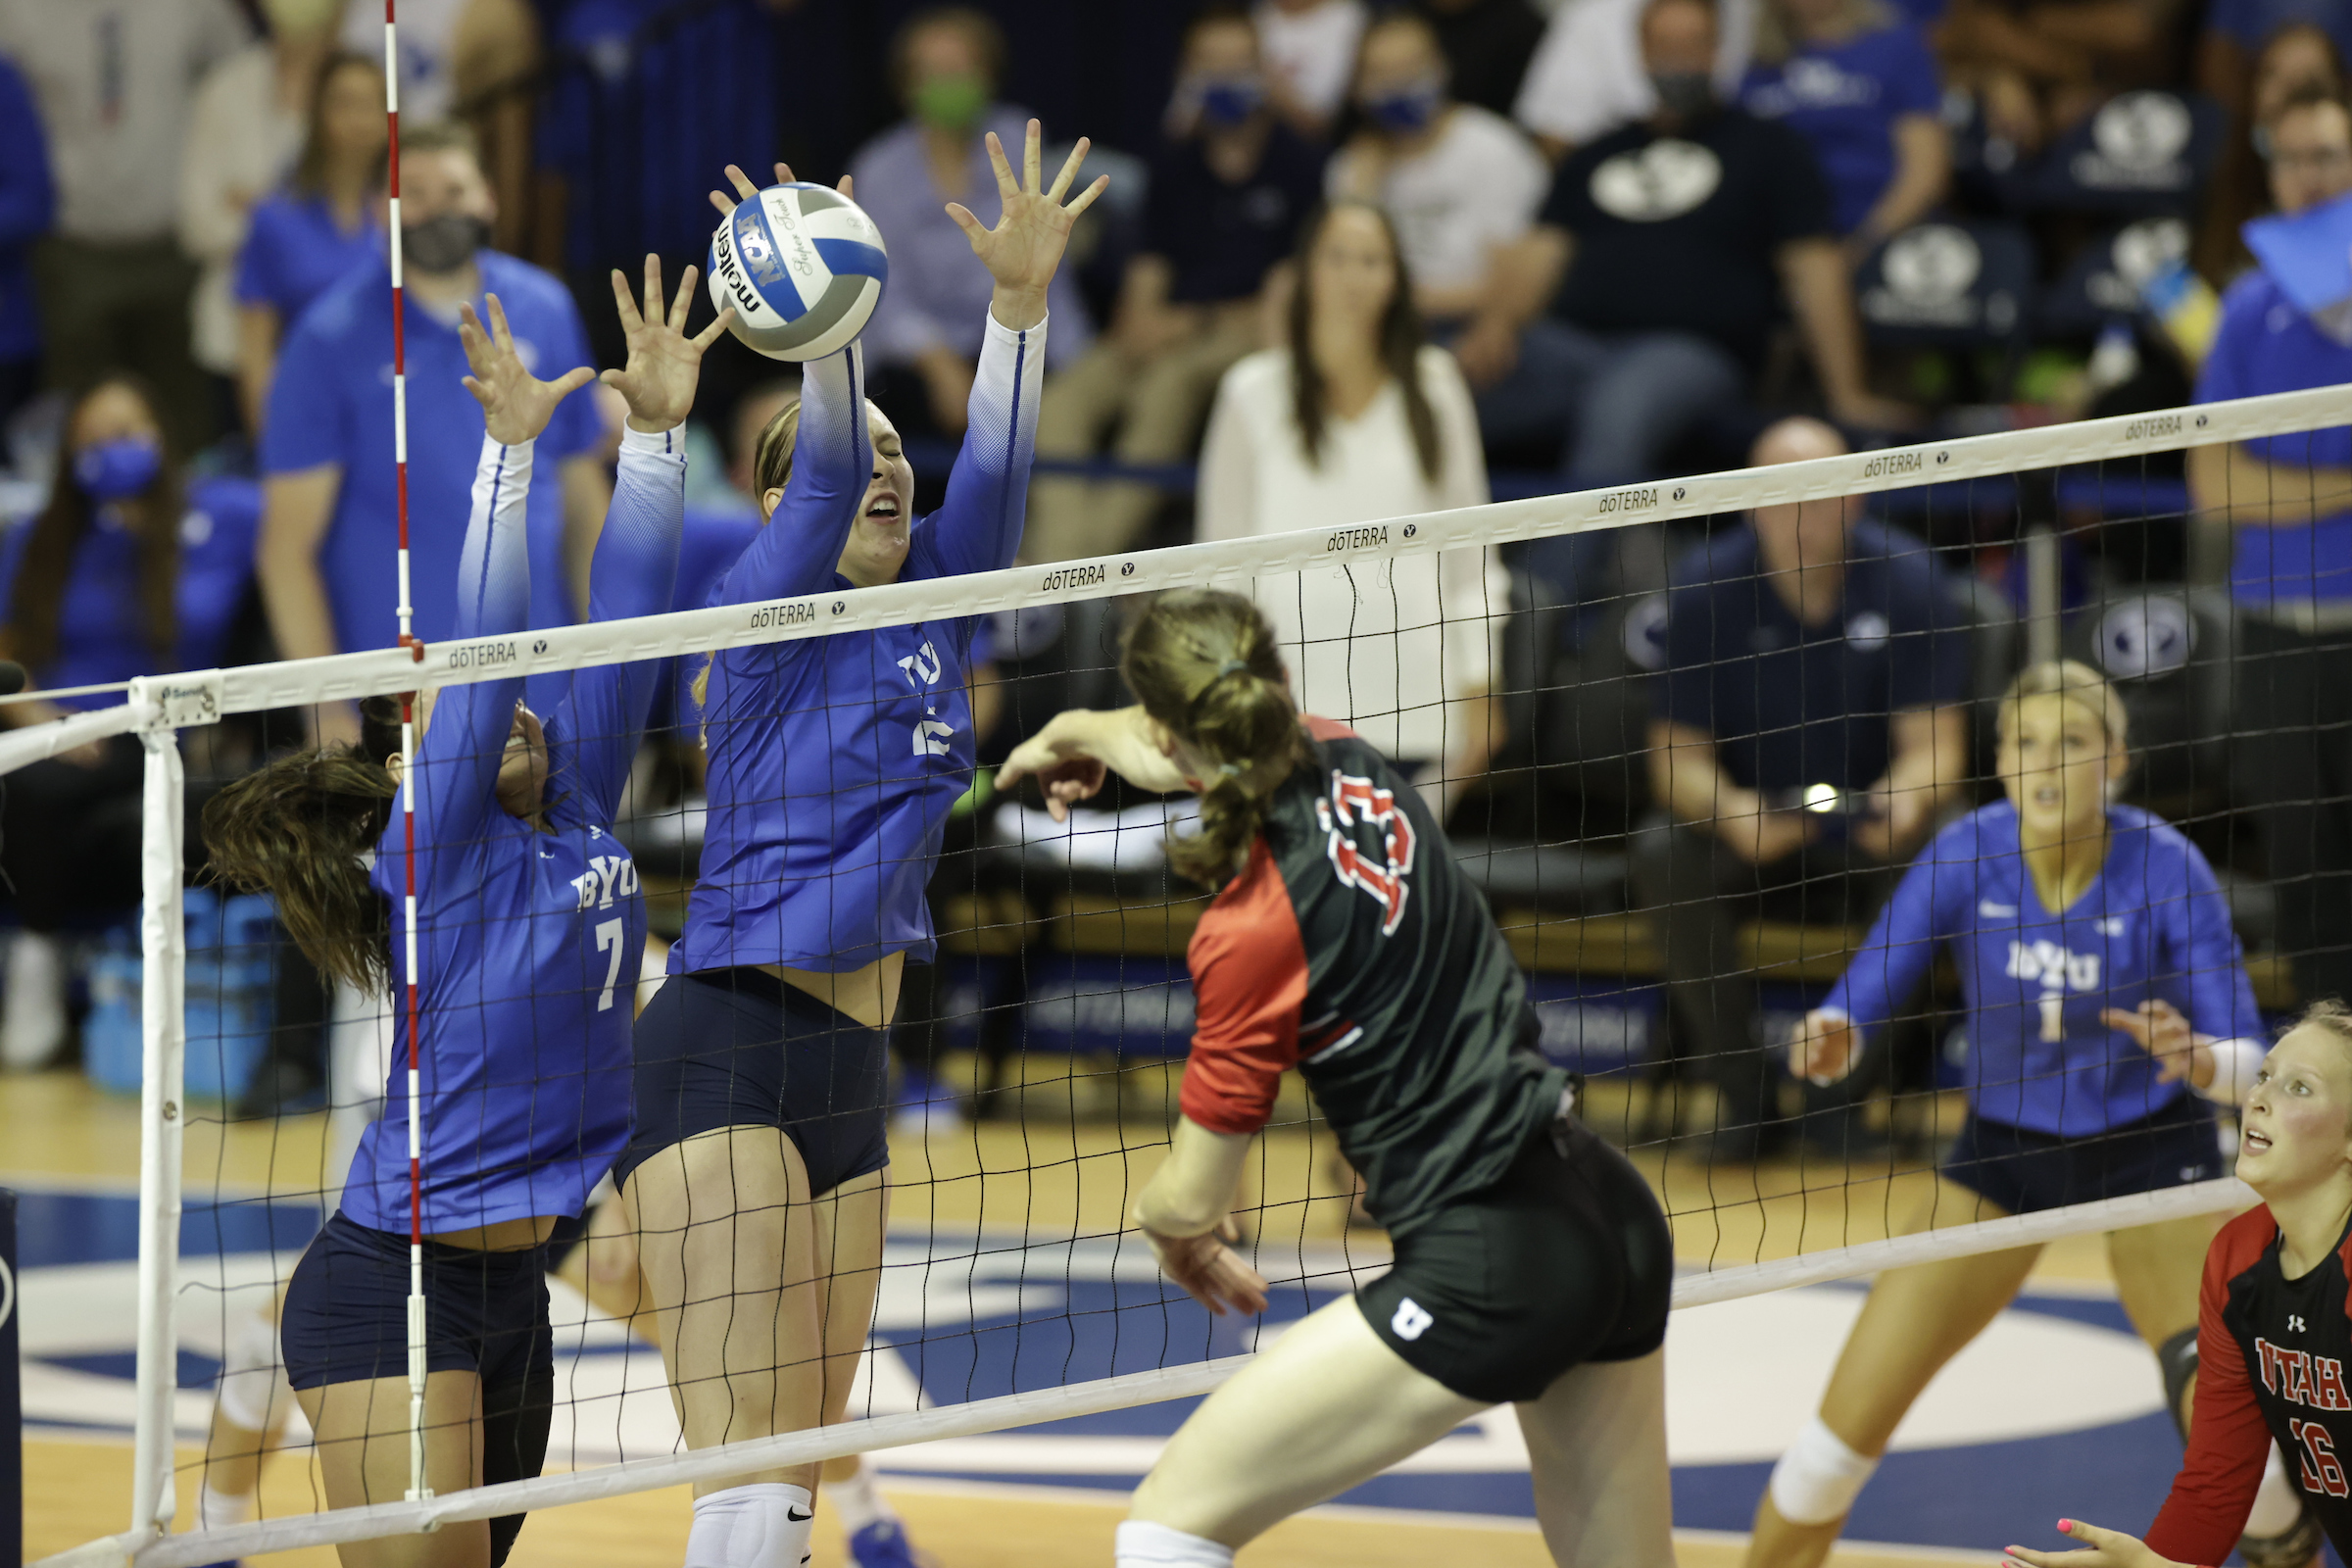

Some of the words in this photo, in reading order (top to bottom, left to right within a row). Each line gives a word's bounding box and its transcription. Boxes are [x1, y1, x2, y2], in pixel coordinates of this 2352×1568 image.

[716, 224, 760, 313] molten
[736, 213, 783, 287] NCAA
[791, 233, 813, 276] Super
[569, 855, 639, 913] BYU
[595, 916, 624, 1012] 7
[2005, 938, 2102, 993] BYU
[2038, 991, 2067, 1044] 1
[2254, 1337, 2352, 1411] UTAH
[2288, 1416, 2350, 1499] 16
